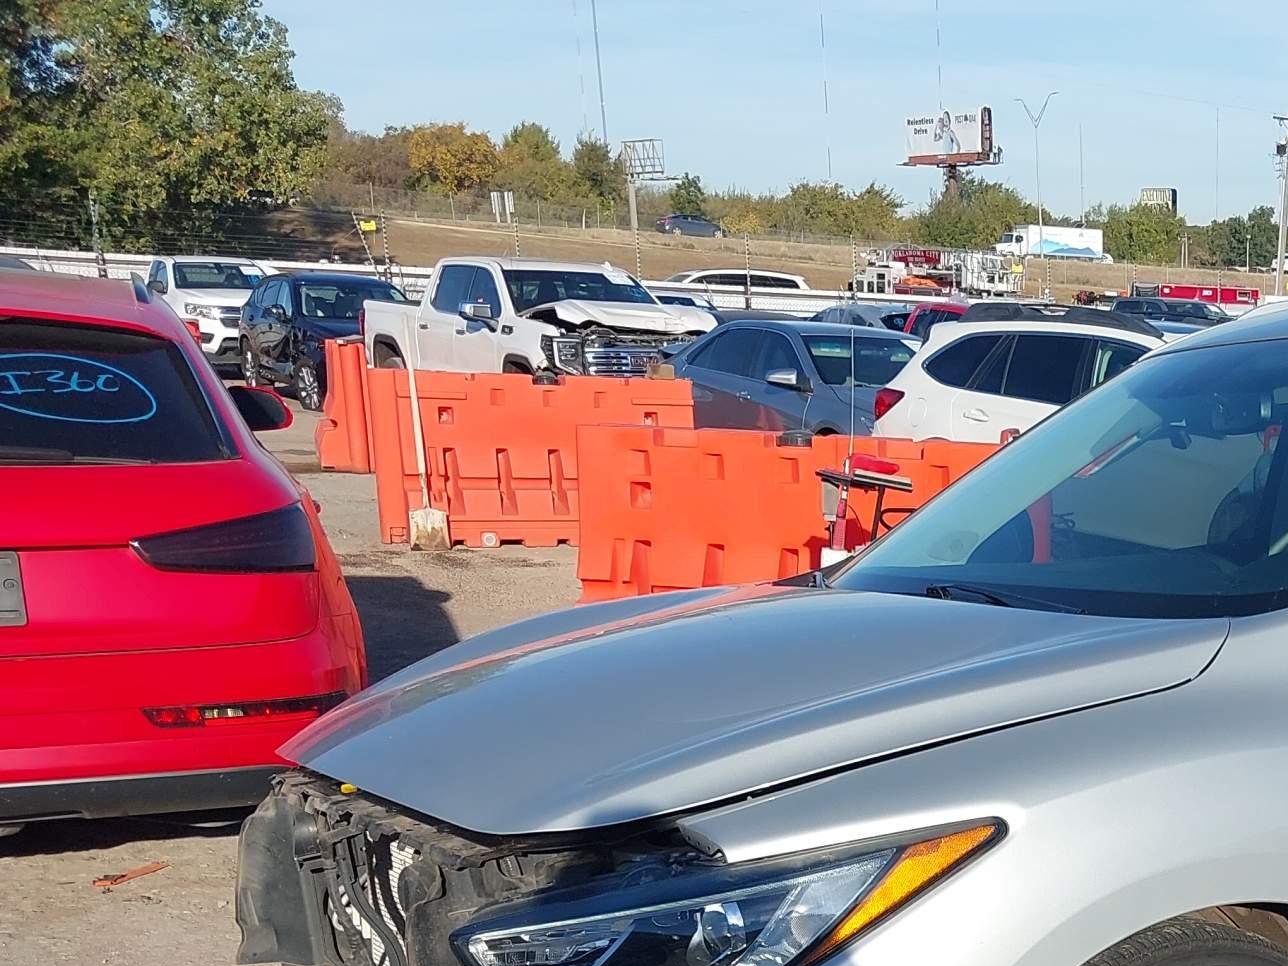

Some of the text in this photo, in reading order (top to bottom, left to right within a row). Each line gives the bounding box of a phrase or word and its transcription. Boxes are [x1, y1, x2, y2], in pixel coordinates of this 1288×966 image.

[907, 117, 935, 127] Relentless
[913, 128, 928, 136] Drive
[895, 250, 925, 258] OKLAHOMA
[925, 250, 939, 260] CITY
